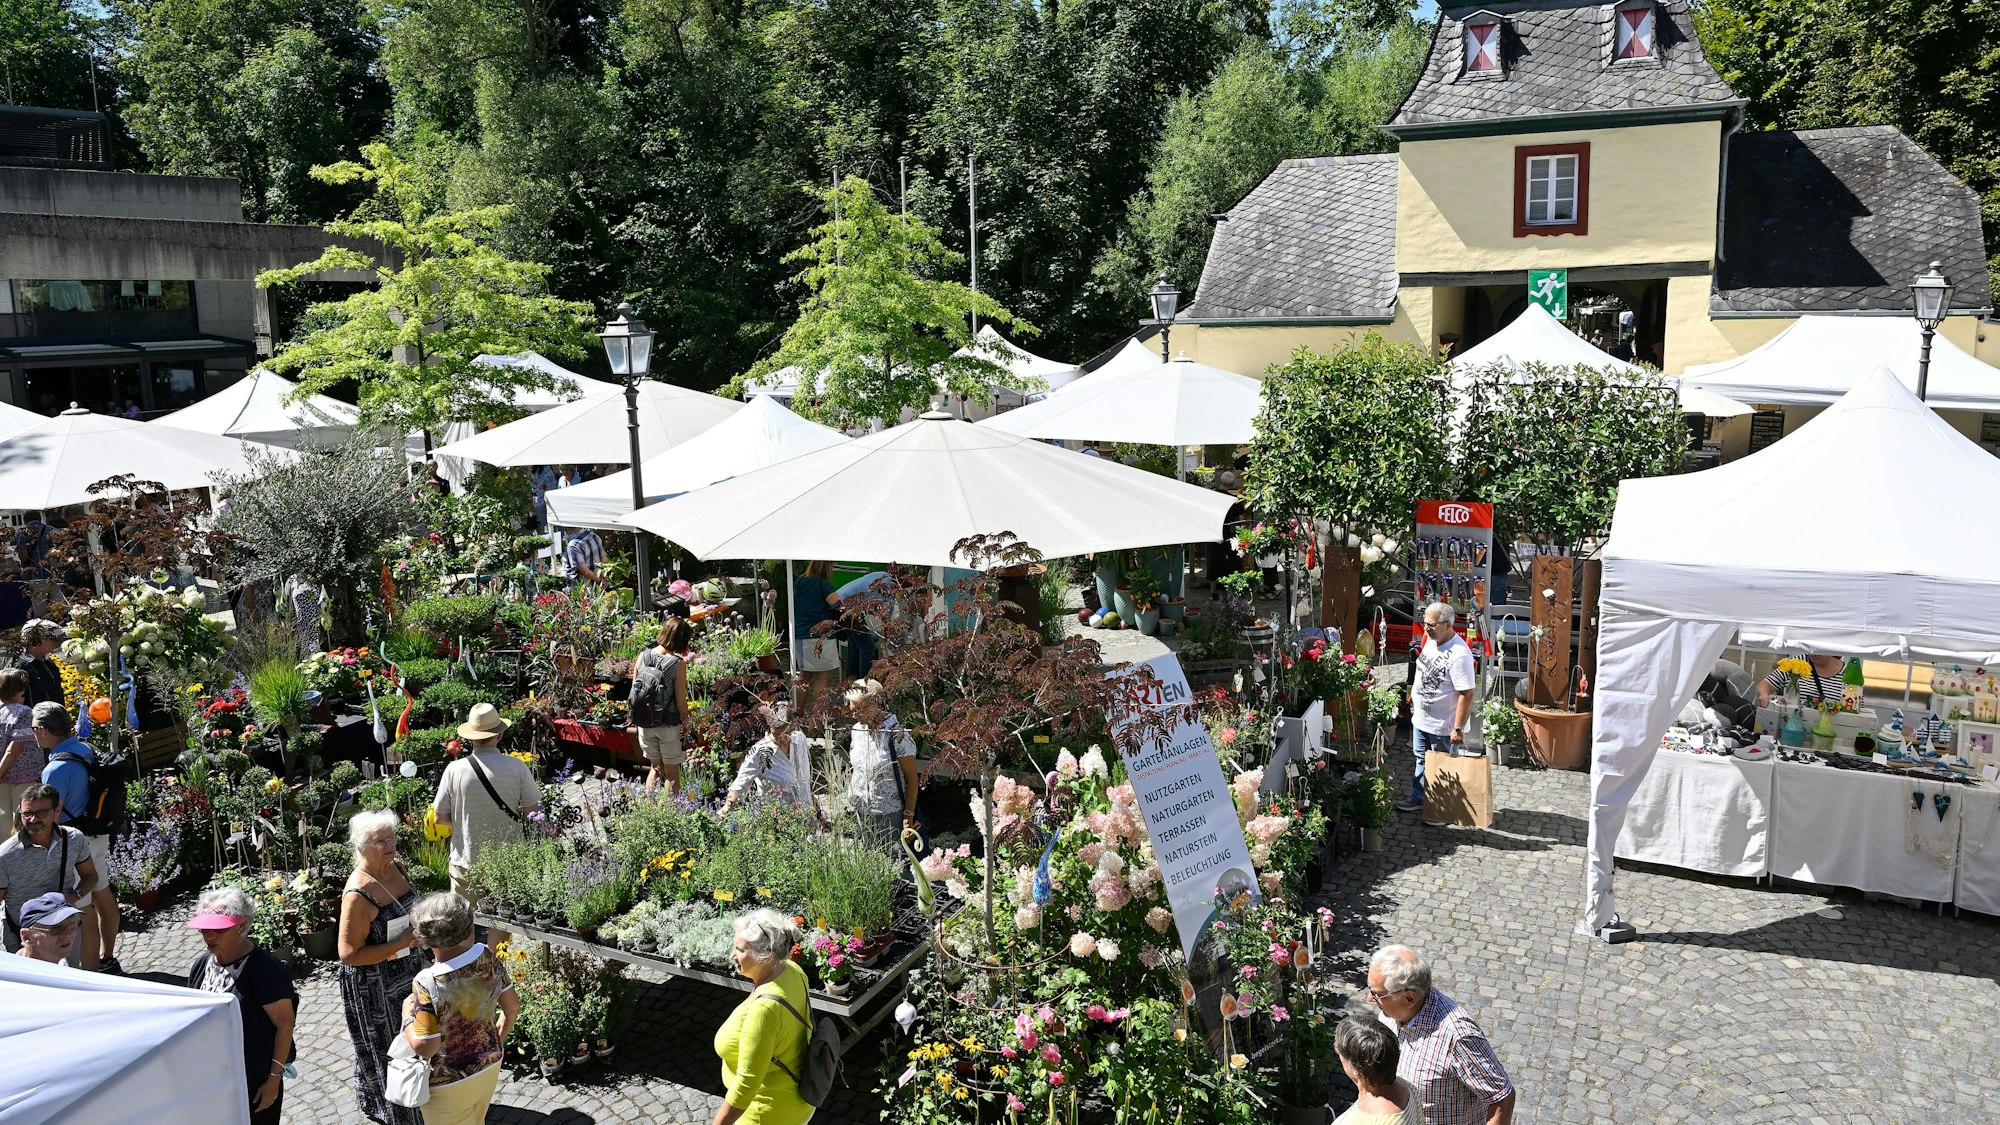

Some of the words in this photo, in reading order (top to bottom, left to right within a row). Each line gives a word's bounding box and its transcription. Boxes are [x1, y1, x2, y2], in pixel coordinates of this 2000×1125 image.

[1438, 504, 1470, 523] FELCO
[1132, 736, 1207, 772] GARTENANLAGEN
[1144, 773, 1202, 804] NUTZGÄRTEN
[1151, 789, 1215, 824] NATURGÄRTEN
[1158, 815, 1207, 844] TERRASSEN
[1164, 832, 1218, 864] NATURSTEIN
